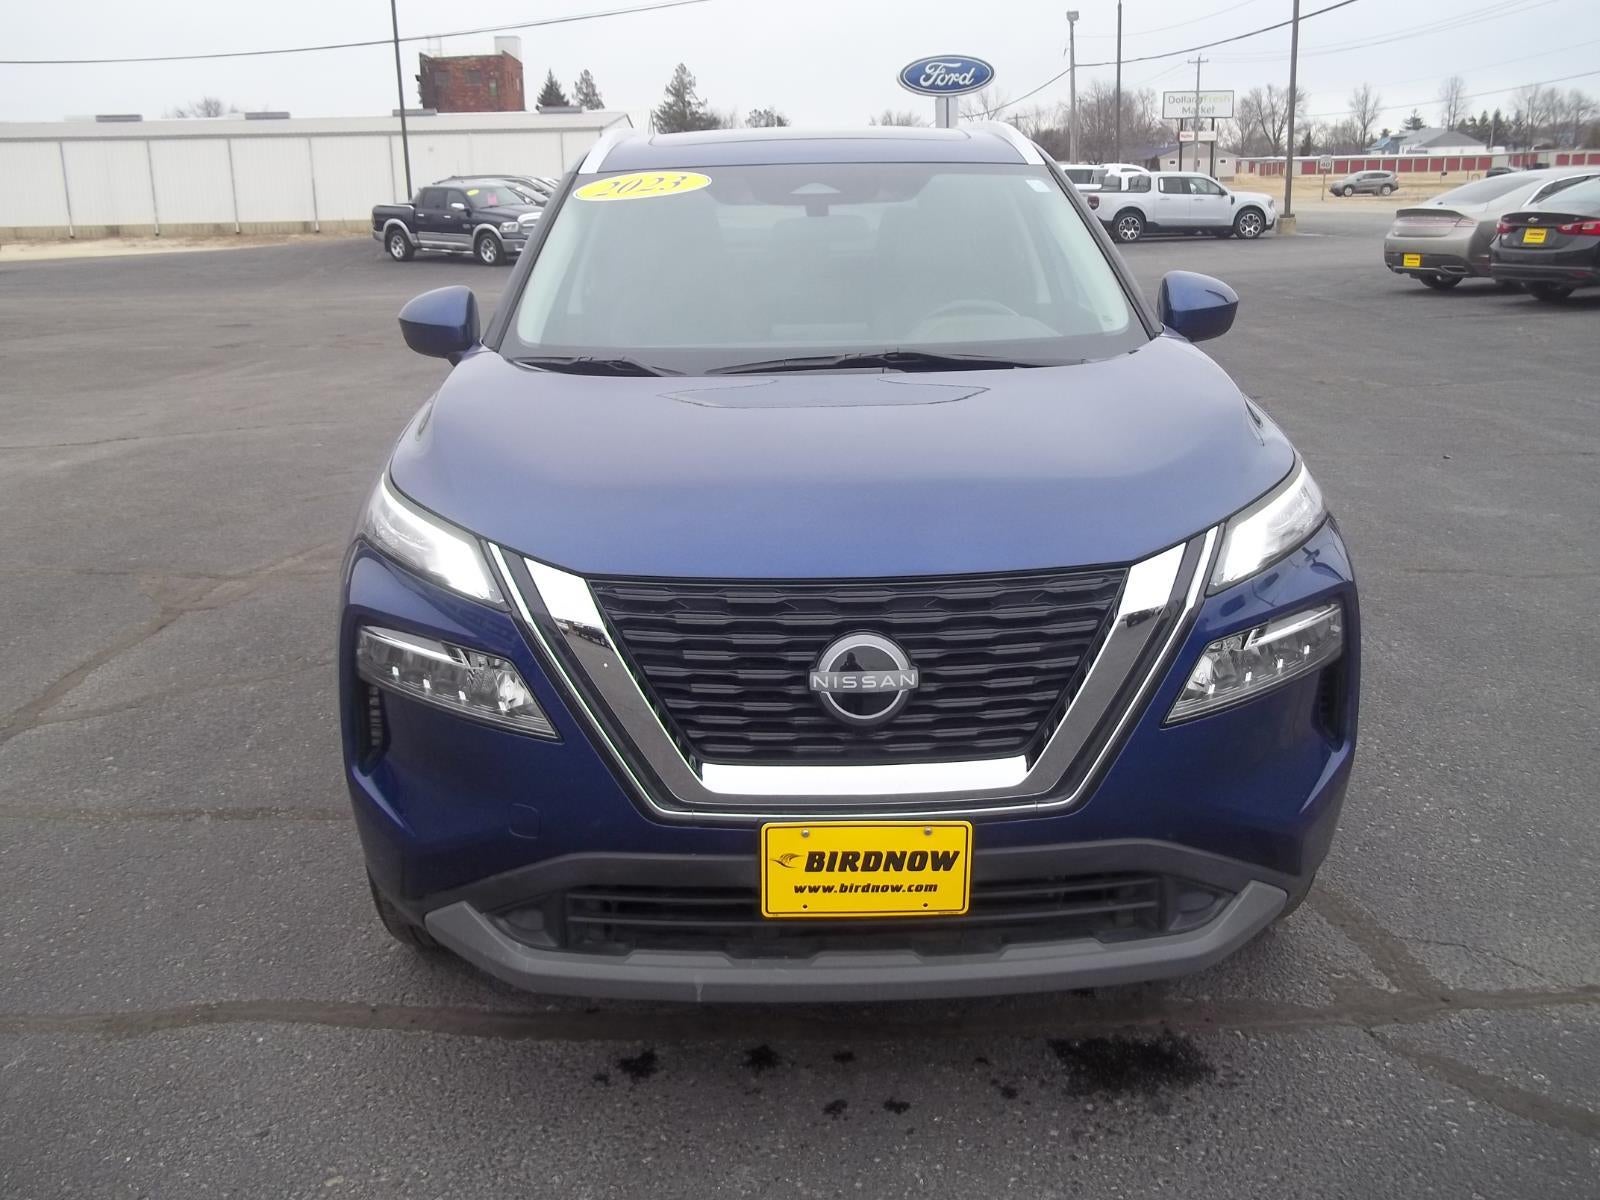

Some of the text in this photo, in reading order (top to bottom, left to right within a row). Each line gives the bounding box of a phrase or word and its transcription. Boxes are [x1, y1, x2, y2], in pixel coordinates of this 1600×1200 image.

[919, 62, 976, 87] Ford
[1181, 104, 1215, 114] Maket
[592, 174, 688, 197] 2023
[812, 672, 915, 690] NISSAN
[804, 850, 960, 873] BIRDNOW
[793, 882, 938, 894] www.birdnow.com
